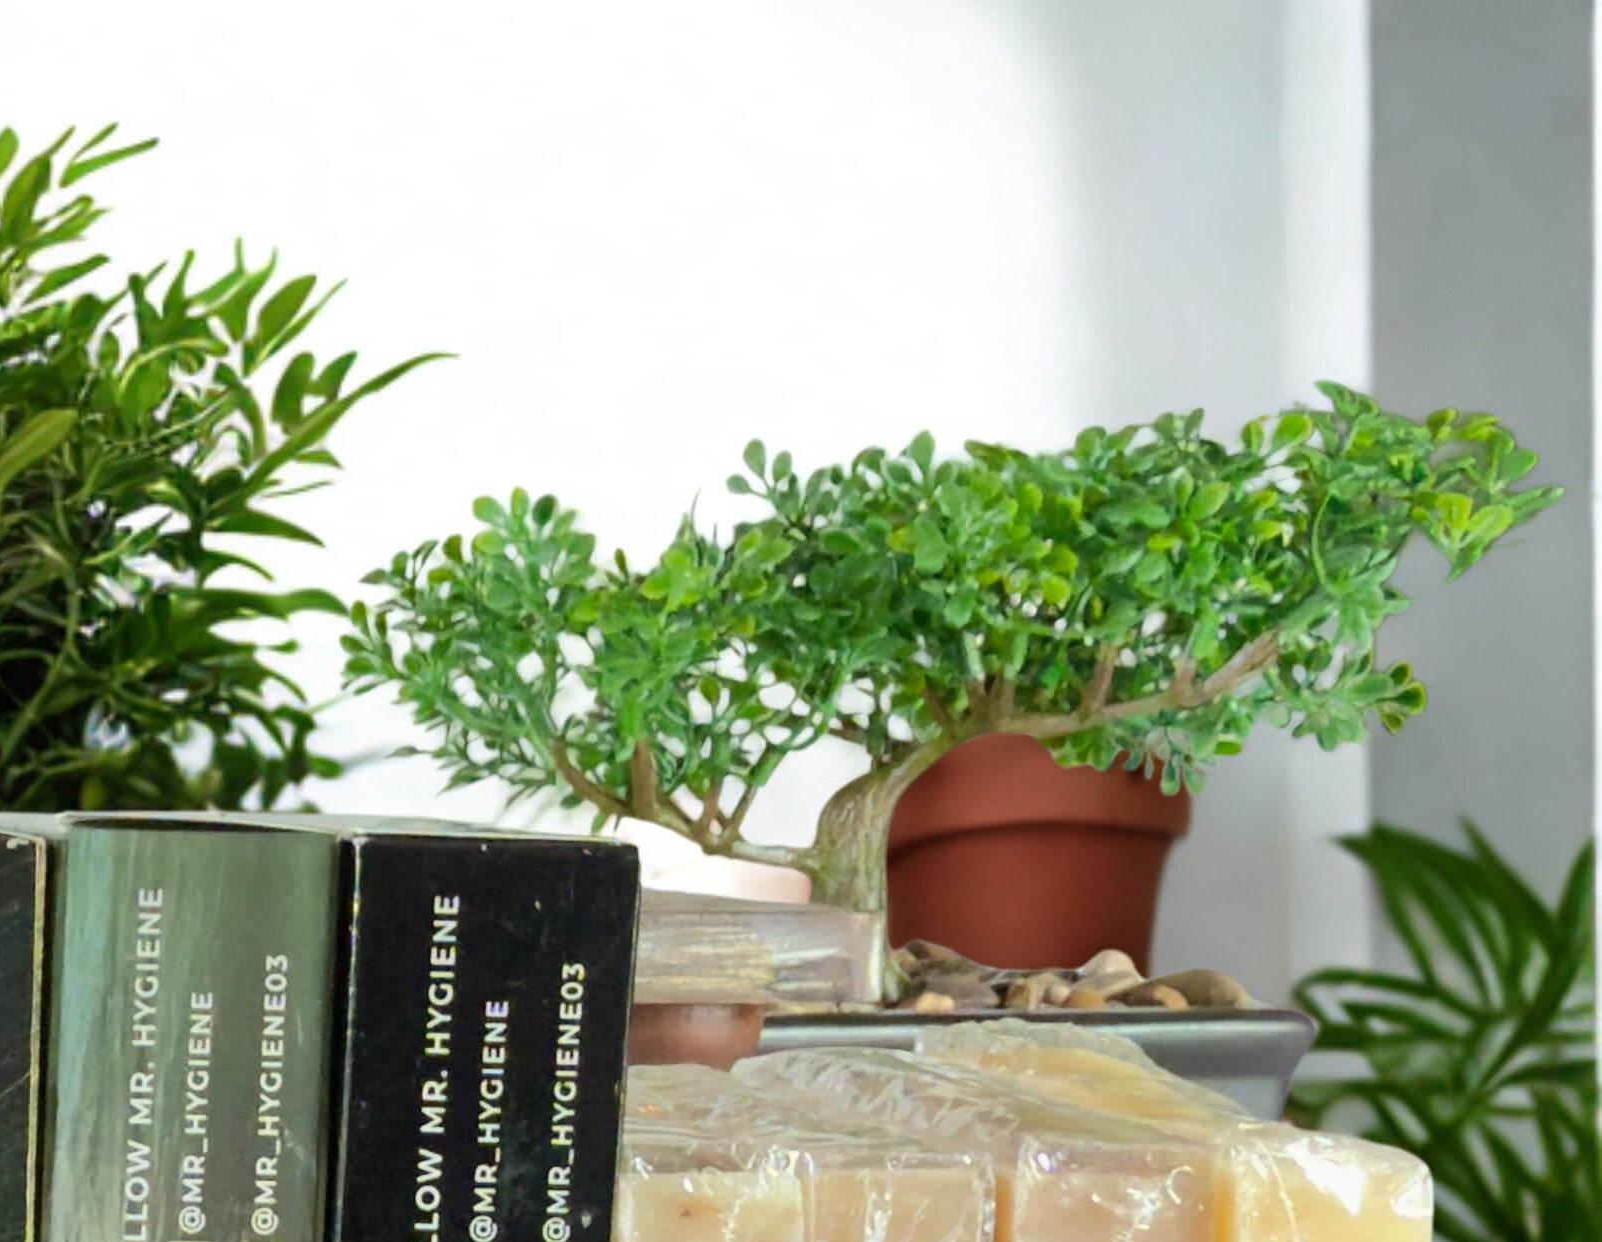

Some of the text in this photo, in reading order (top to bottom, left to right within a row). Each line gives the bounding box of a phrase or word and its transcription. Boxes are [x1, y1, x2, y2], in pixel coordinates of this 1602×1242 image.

[130, 888, 164, 1046] HYGIENE
[425, 895, 461, 1056] HYGIENE
[128, 1060, 156, 1125] MR.
[179, 992, 213, 1235] @MR_HYGIENE
[251, 954, 289, 1236] @MR_HYGIENE03
[418, 1069, 449, 1134] MR.
